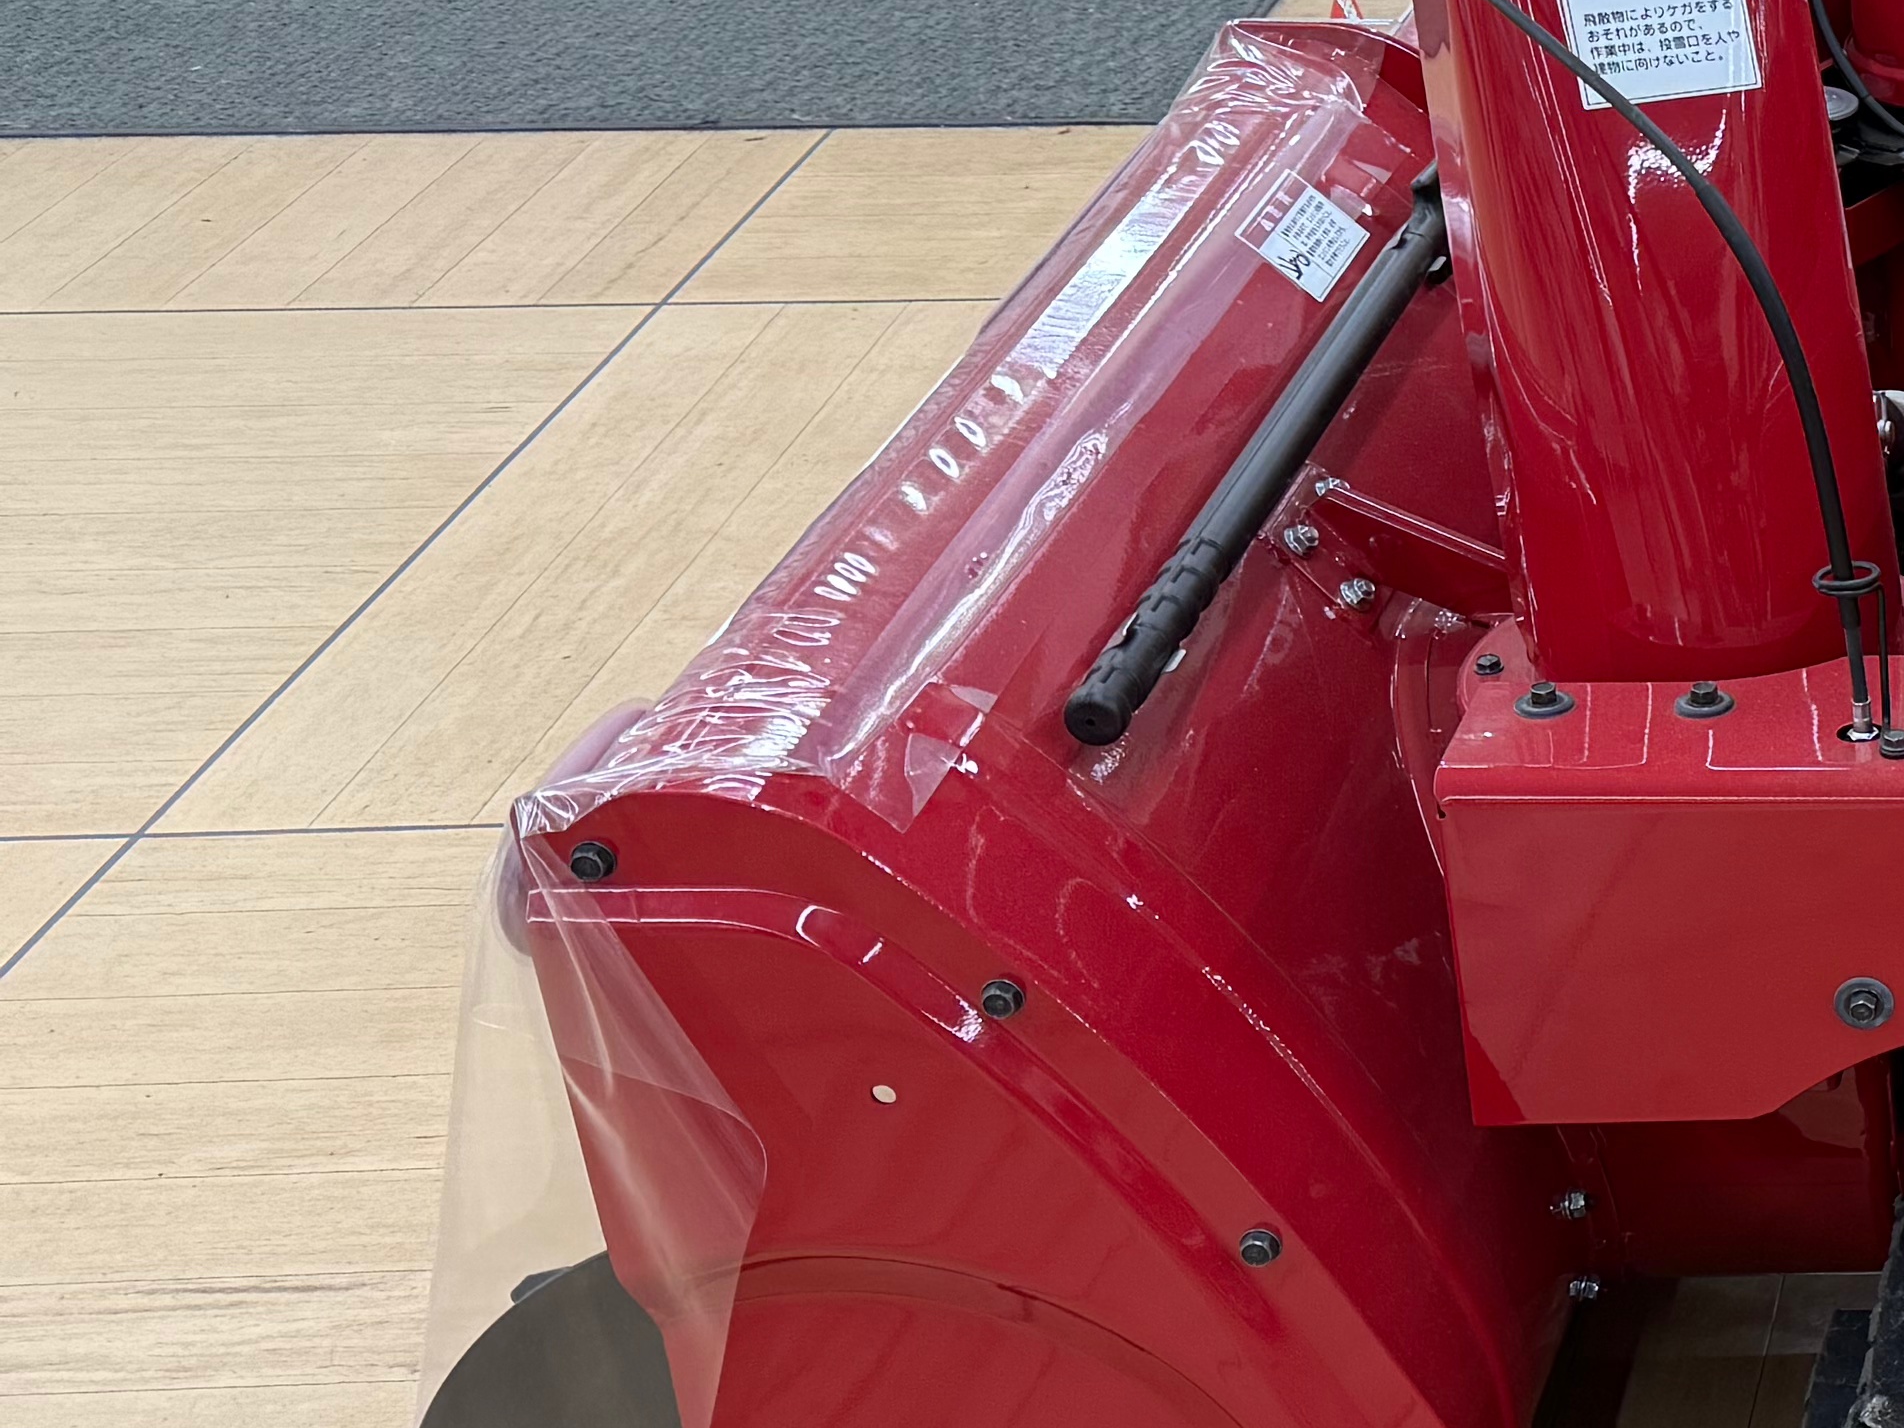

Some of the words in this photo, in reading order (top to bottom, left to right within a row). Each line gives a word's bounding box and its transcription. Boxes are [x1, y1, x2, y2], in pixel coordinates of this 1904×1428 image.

[1588, 18, 1703, 43] おそれがあるので、
[1590, 29, 1740, 60] 作業中は、投雪口を人や
[1593, 51, 1724, 75] 建物に向けないこと。
